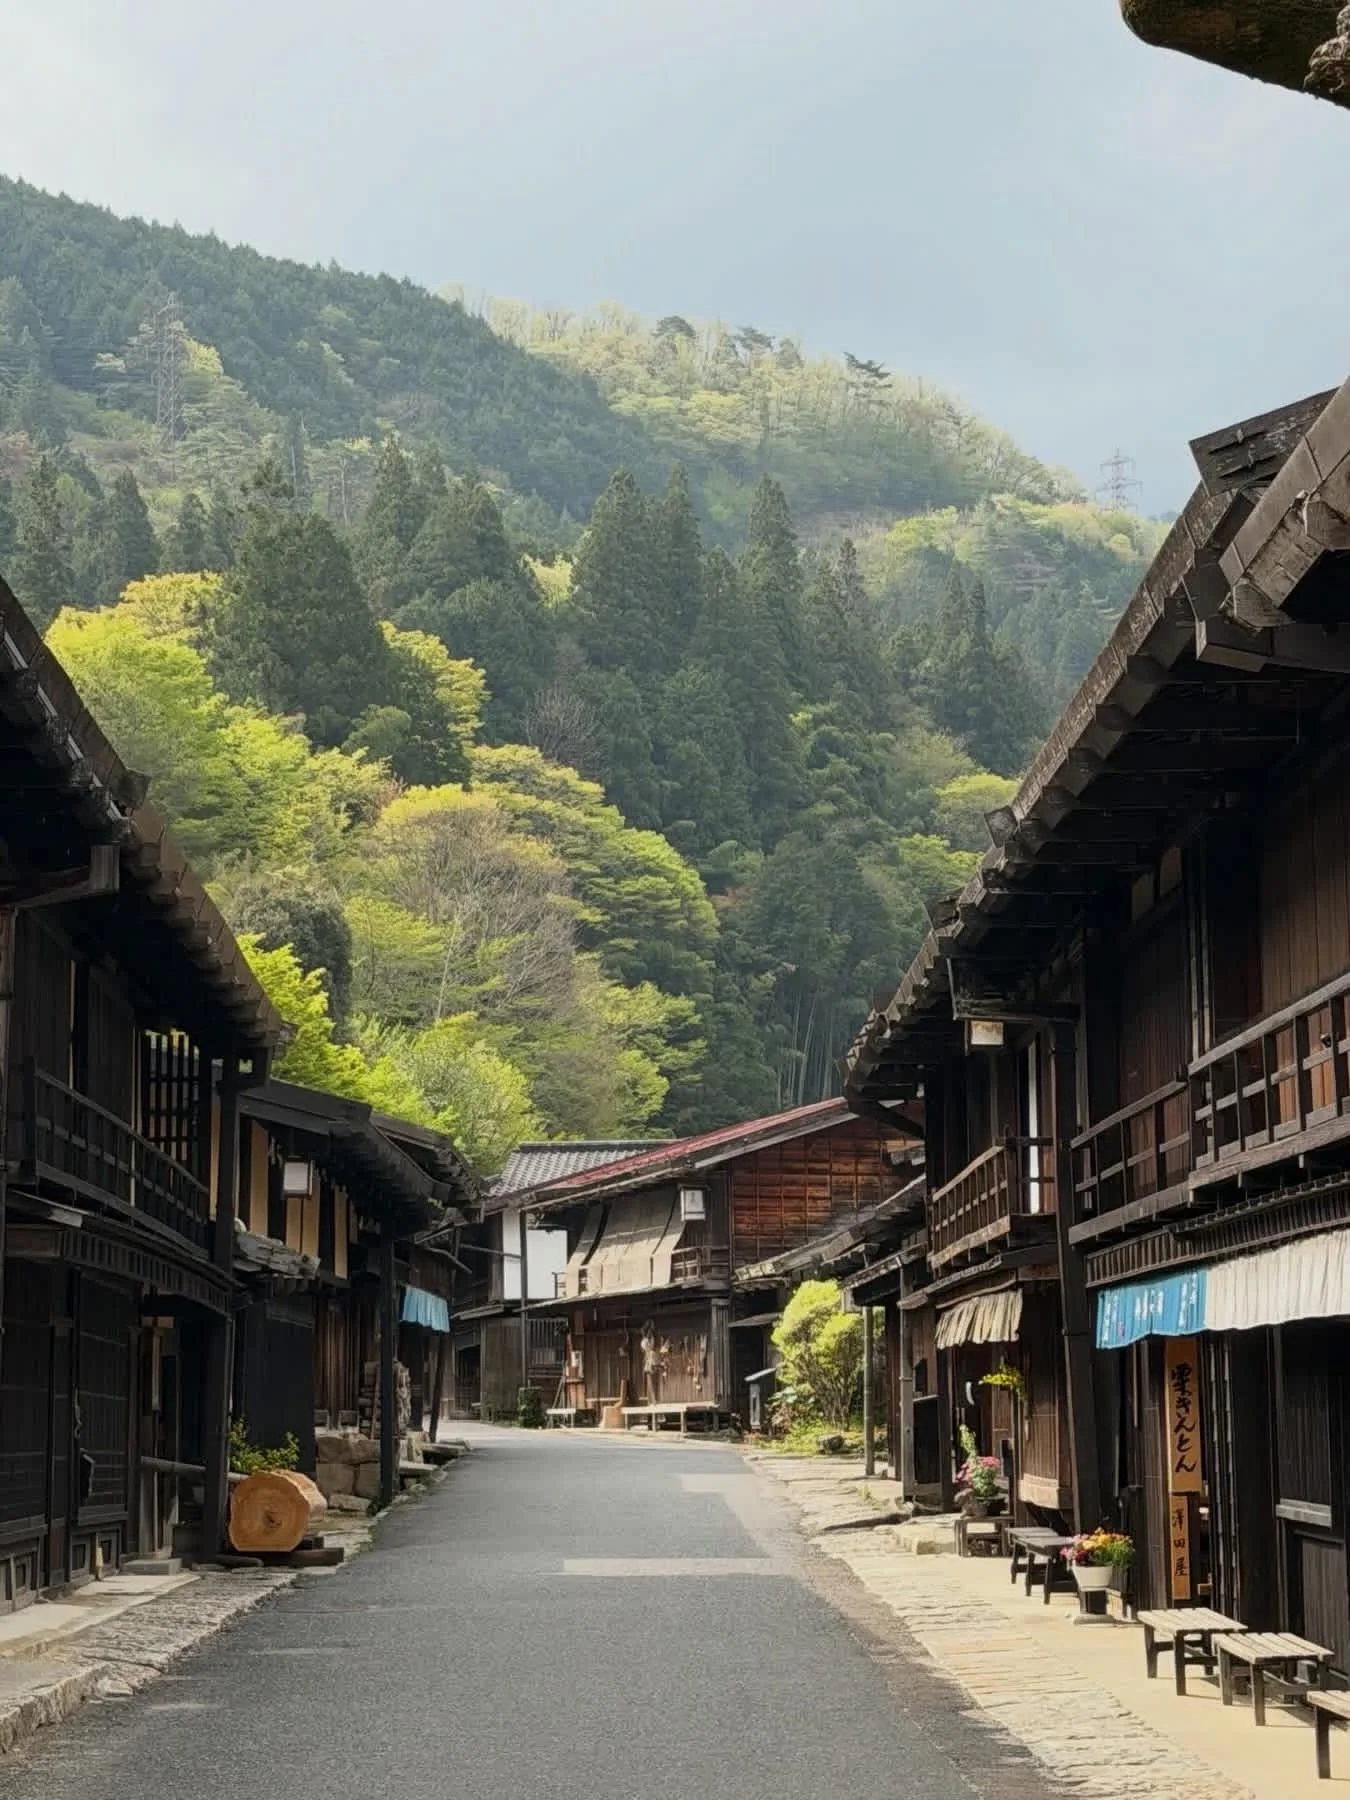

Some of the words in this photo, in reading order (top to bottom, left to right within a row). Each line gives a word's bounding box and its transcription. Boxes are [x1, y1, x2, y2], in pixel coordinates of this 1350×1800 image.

[1171, 1363, 1196, 1472] 栗きんとん
